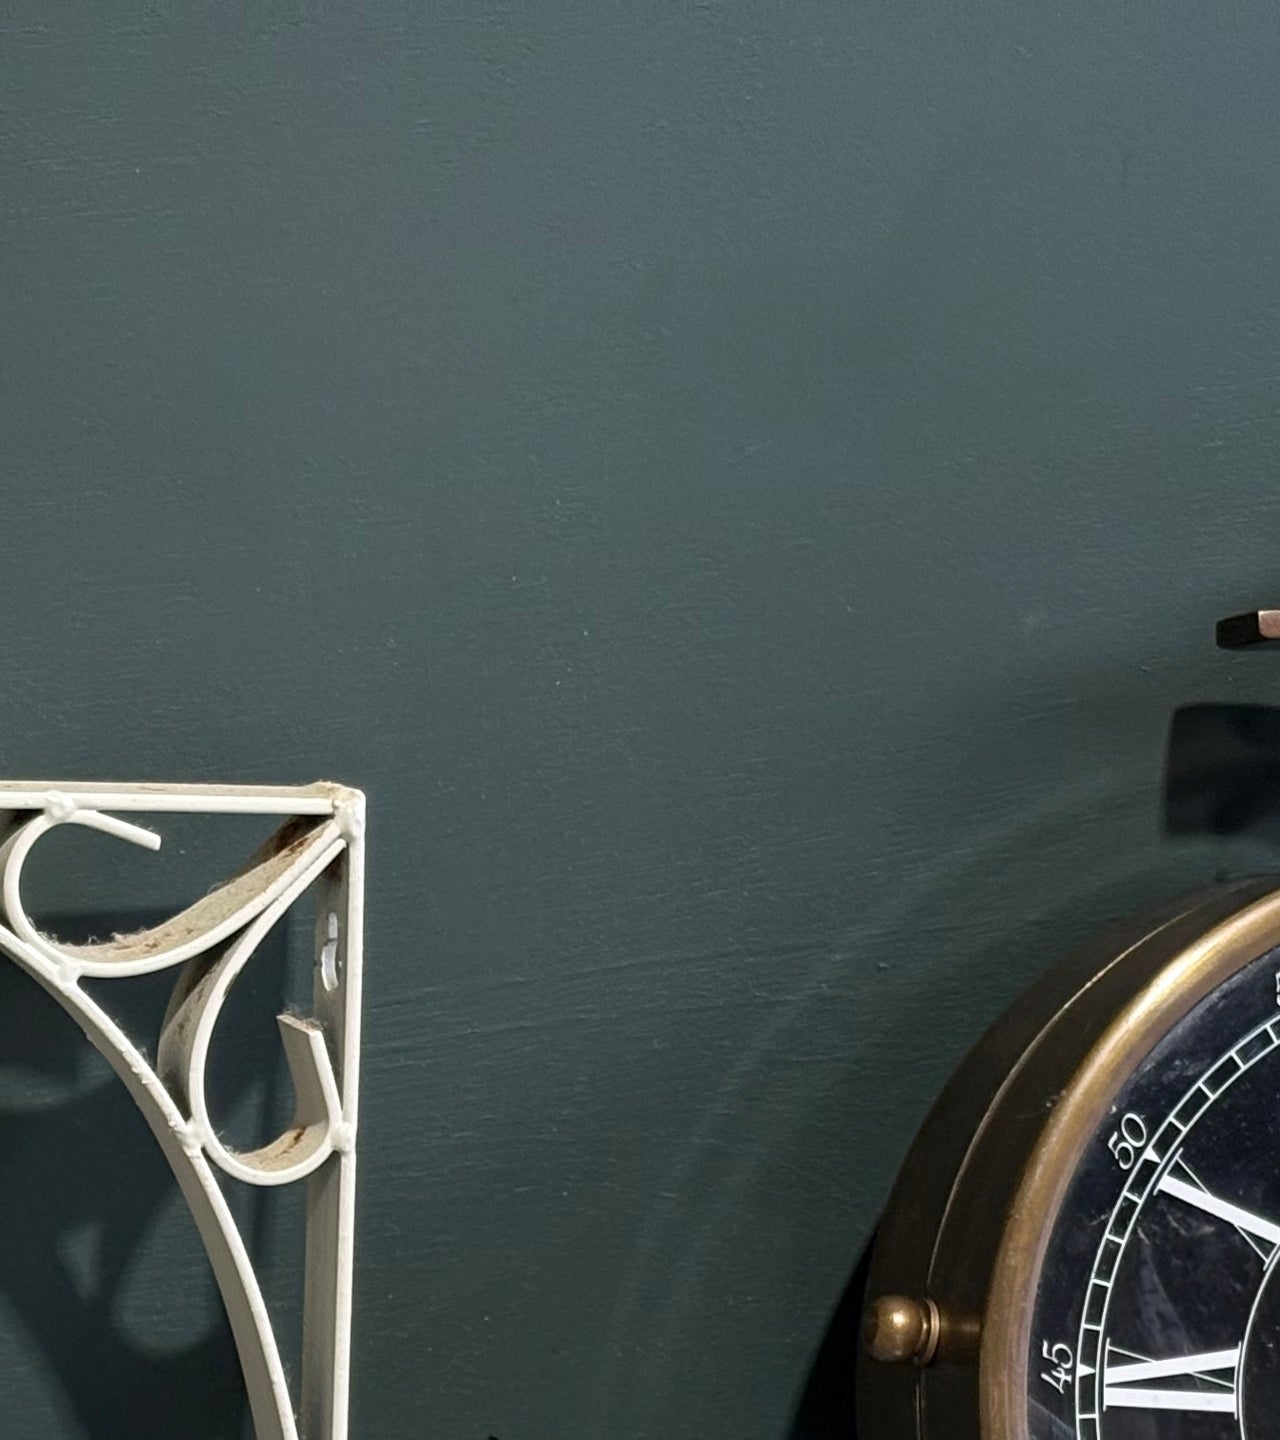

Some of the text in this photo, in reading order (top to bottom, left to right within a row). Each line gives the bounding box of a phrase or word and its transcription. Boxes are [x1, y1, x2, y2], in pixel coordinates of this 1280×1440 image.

[1107, 1112, 1148, 1171] 50
[1040, 1338, 1075, 1396] 45
[1102, 1336, 1242, 1420] IX
